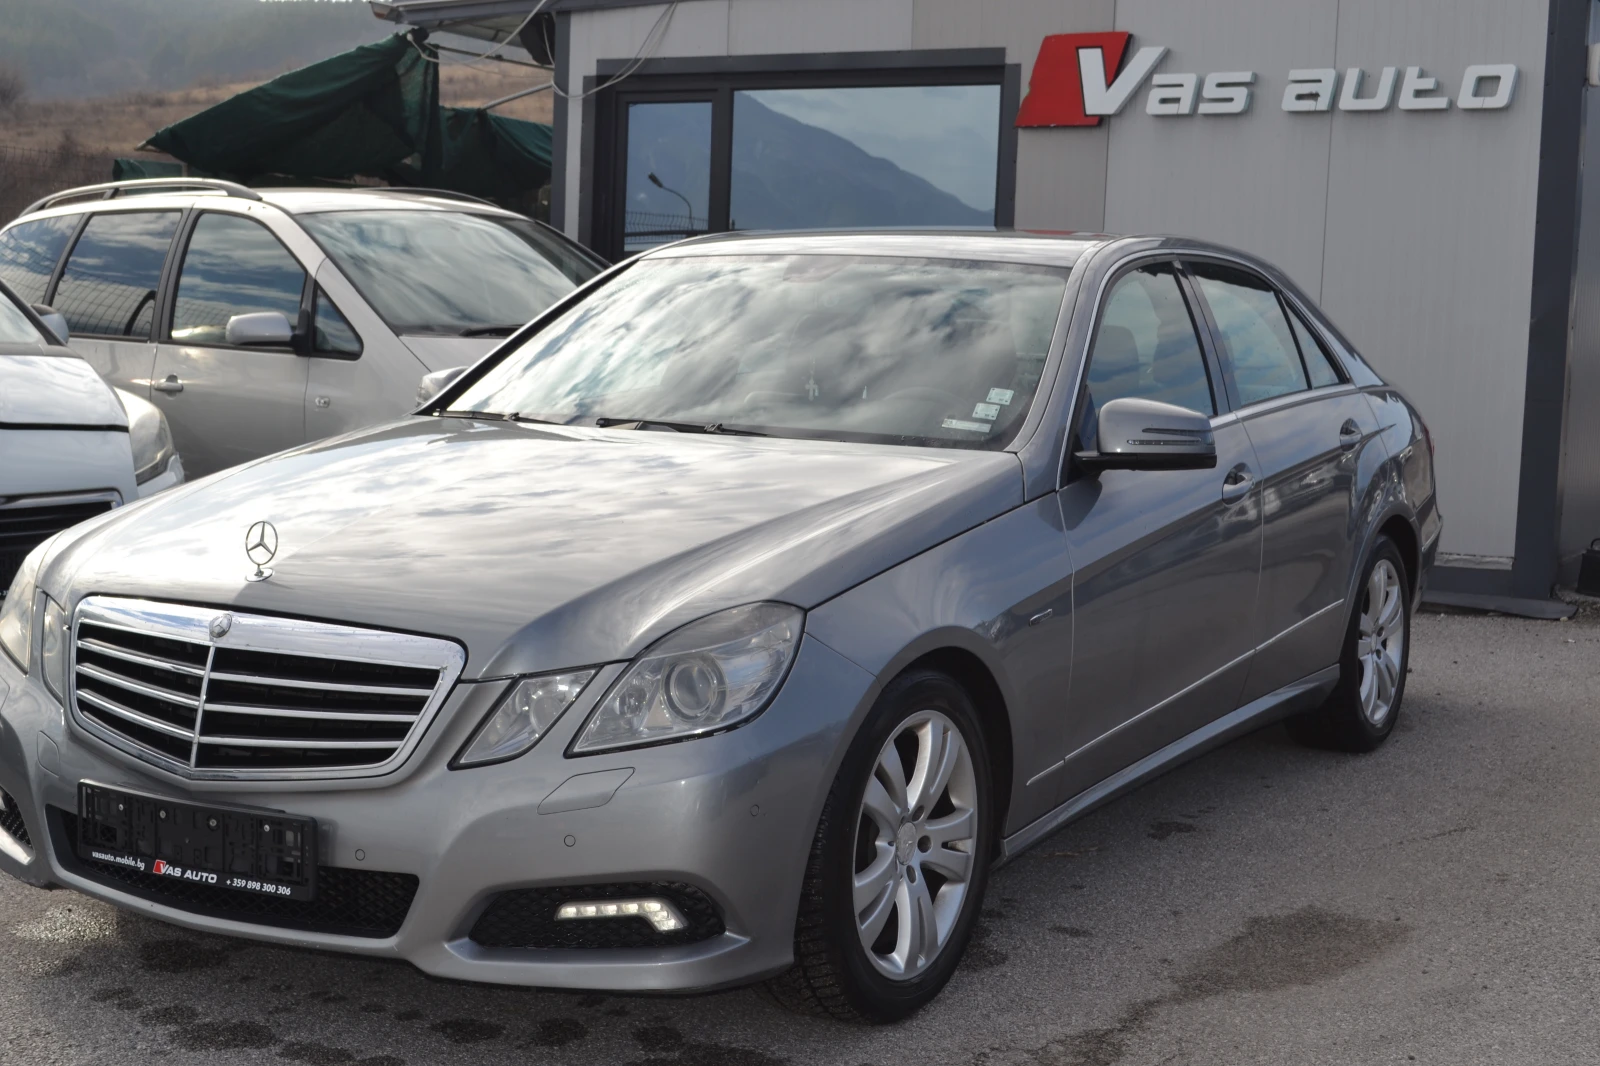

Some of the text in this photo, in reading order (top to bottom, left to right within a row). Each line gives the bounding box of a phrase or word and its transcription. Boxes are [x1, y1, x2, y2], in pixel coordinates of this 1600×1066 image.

[1076, 46, 1520, 116] Vas auto
[92, 851, 145, 871] vasauto.mobile.bg
[160, 863, 218, 883] VAS AUTO
[246, 880, 261, 890] 898
[261, 883, 276, 893] 300
[276, 885, 291, 895] 306
